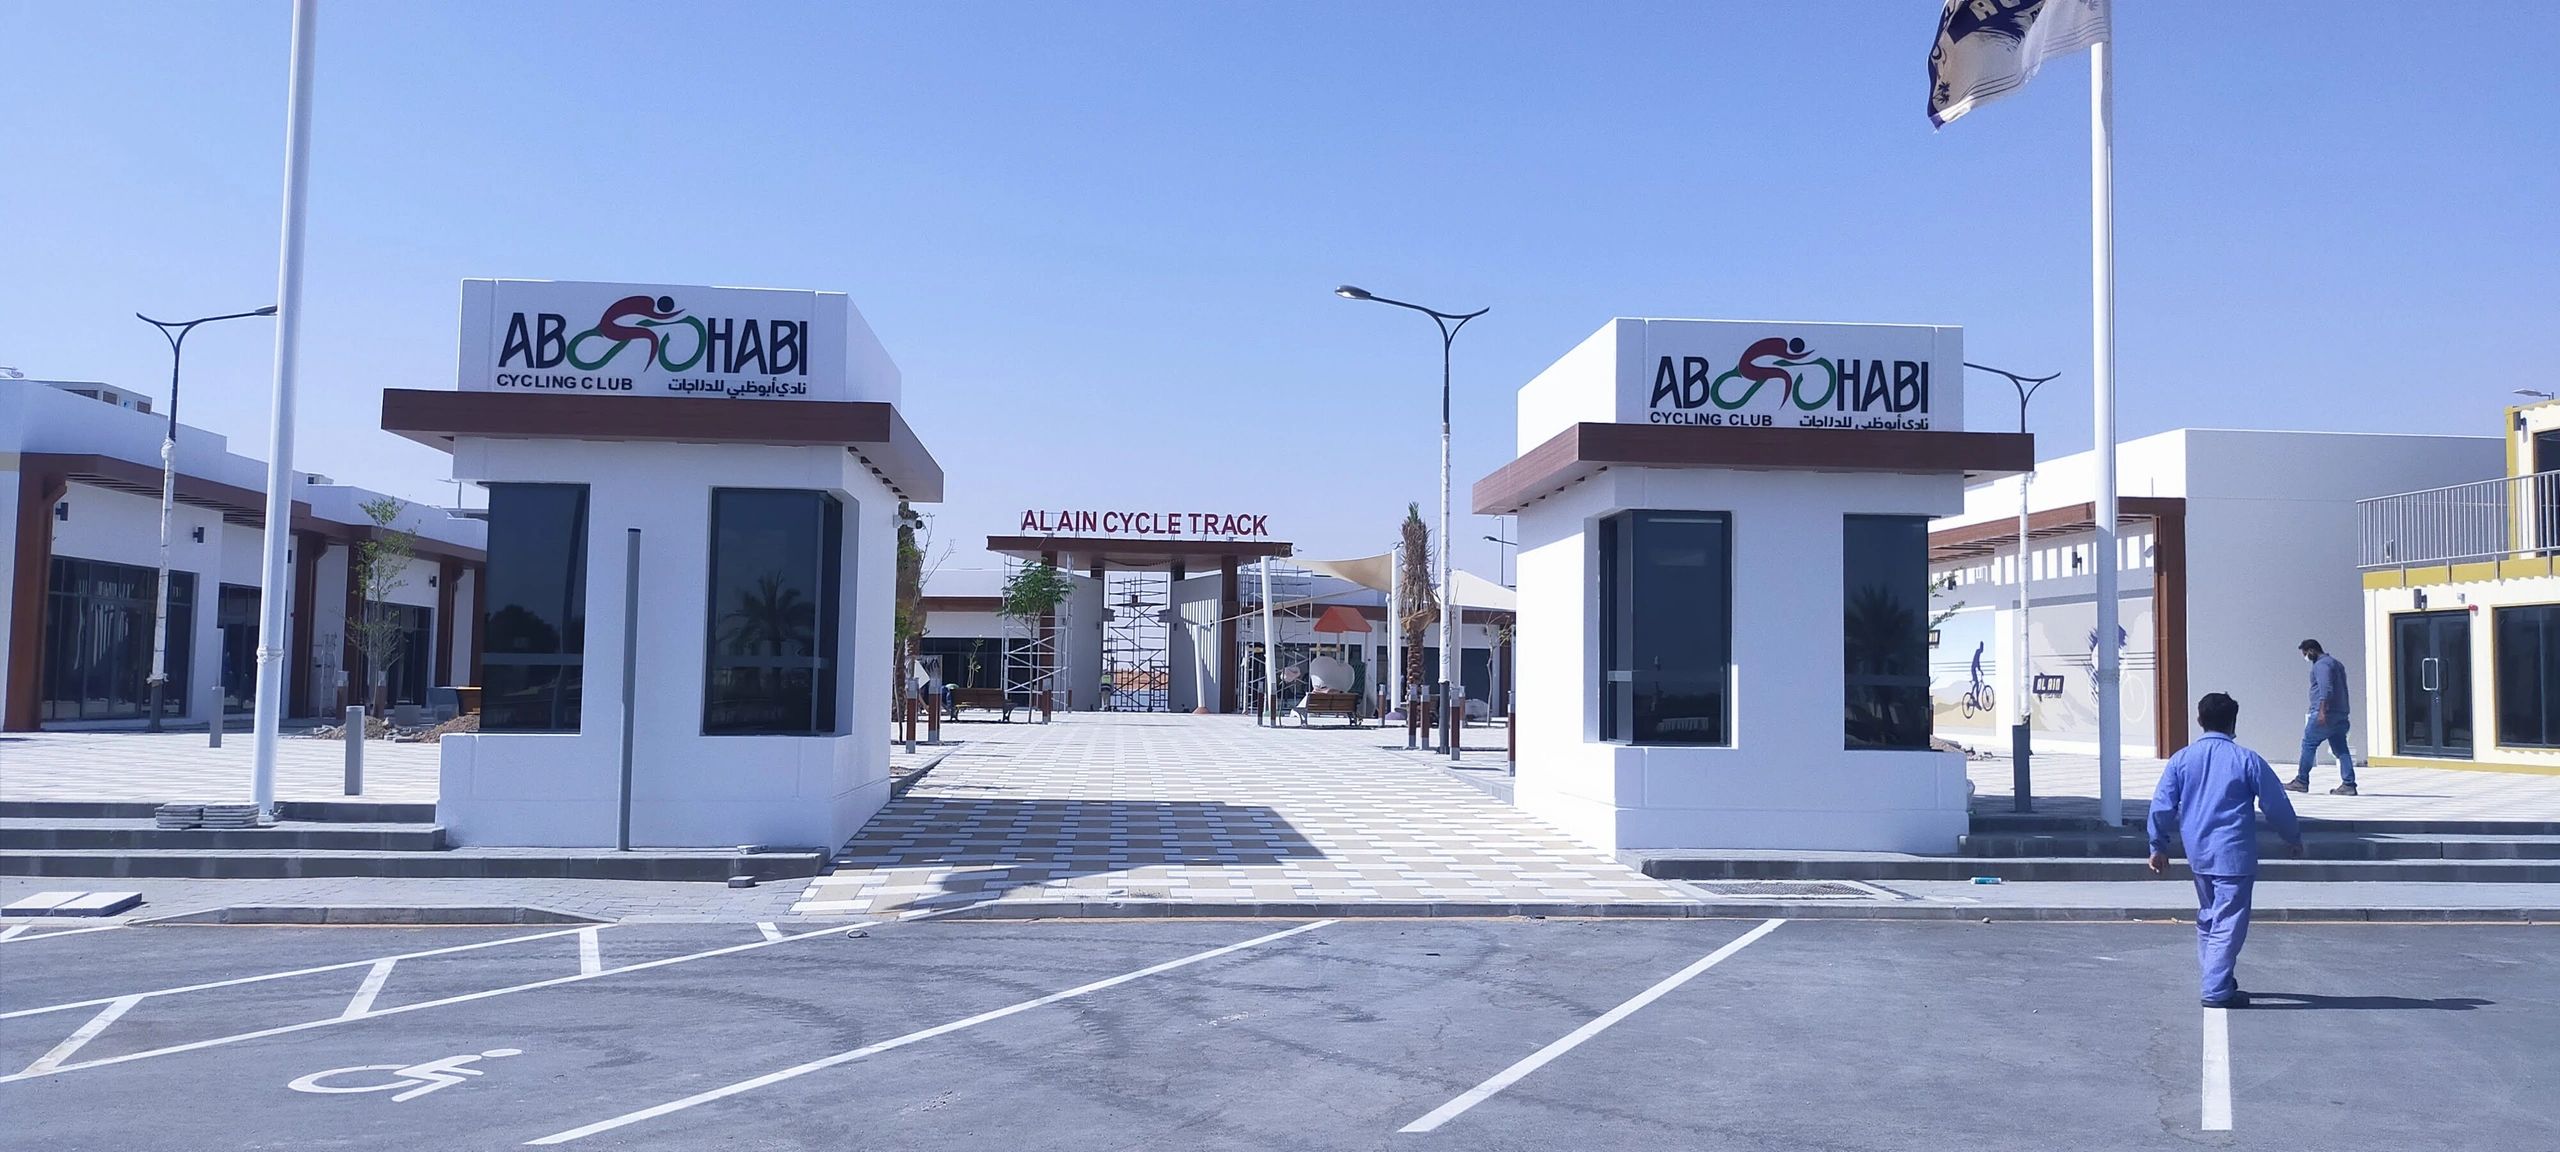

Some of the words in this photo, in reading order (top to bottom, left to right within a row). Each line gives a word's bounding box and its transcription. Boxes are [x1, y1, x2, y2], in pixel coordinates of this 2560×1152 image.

[496, 373, 577, 389] CYCLING
[581, 376, 633, 391] CLUB
[776, 382, 807, 397] نادي
[1650, 411, 1722, 426] CYCLING
[1729, 413, 1773, 427] CLUB
[1103, 511, 1182, 534] CYCLE
[1188, 513, 1268, 536] TRACK
